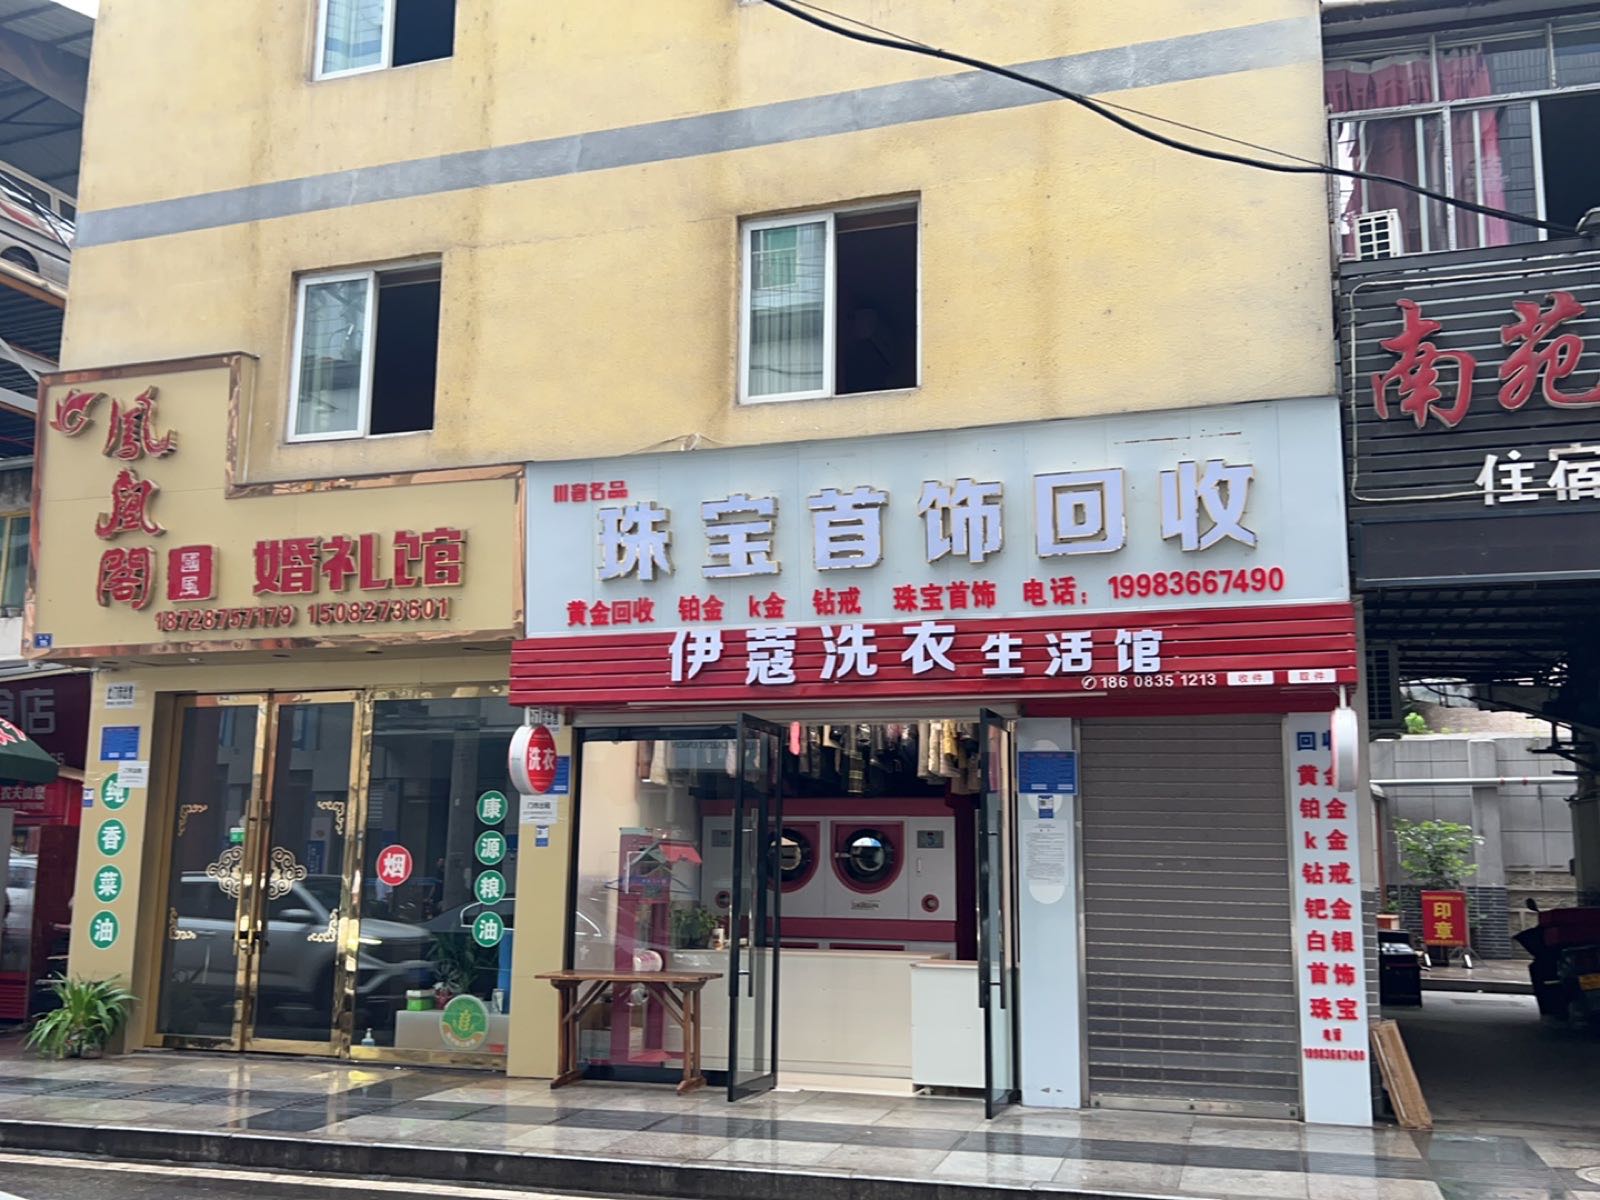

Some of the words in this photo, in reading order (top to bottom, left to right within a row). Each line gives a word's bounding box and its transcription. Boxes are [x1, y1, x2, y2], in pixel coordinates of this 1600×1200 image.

[1371, 290, 1600, 430] 南苑
[1475, 442, 1600, 506] 住宿
[596, 458, 1257, 582] 珠宝首饰回收
[252, 526, 464, 596] 婚礼馆
[567, 597, 655, 627] 黄金回收
[679, 593, 725, 622] 铂金
[748, 590, 785, 620] k金
[813, 586, 862, 616] 钻戒
[893, 579, 997, 613] 珠宝首饰
[1108, 566, 1286, 600] 19983667490
[155, 605, 295, 631] 18728757179
[307, 598, 449, 625] 1508273601
[667, 621, 1164, 687] 伊蔻洗衣生活馆
[1100, 676, 1128, 689] 186
[1133, 675, 1174, 688] 0835
[1180, 673, 1217, 686] 1213
[528, 746, 555, 771] 洗衣
[1299, 797, 1348, 819] 铂金
[1304, 829, 1349, 850] k金
[382, 852, 406, 879] 烟
[478, 797, 502, 941] 康源粮油
[1302, 861, 1356, 885] 钻戒
[1304, 898, 1352, 919] 钯金
[1433, 902, 1453, 940] 印章
[1307, 929, 1354, 952] 白银
[1307, 962, 1355, 986] 首饰
[1309, 998, 1359, 1020] 珠宝
